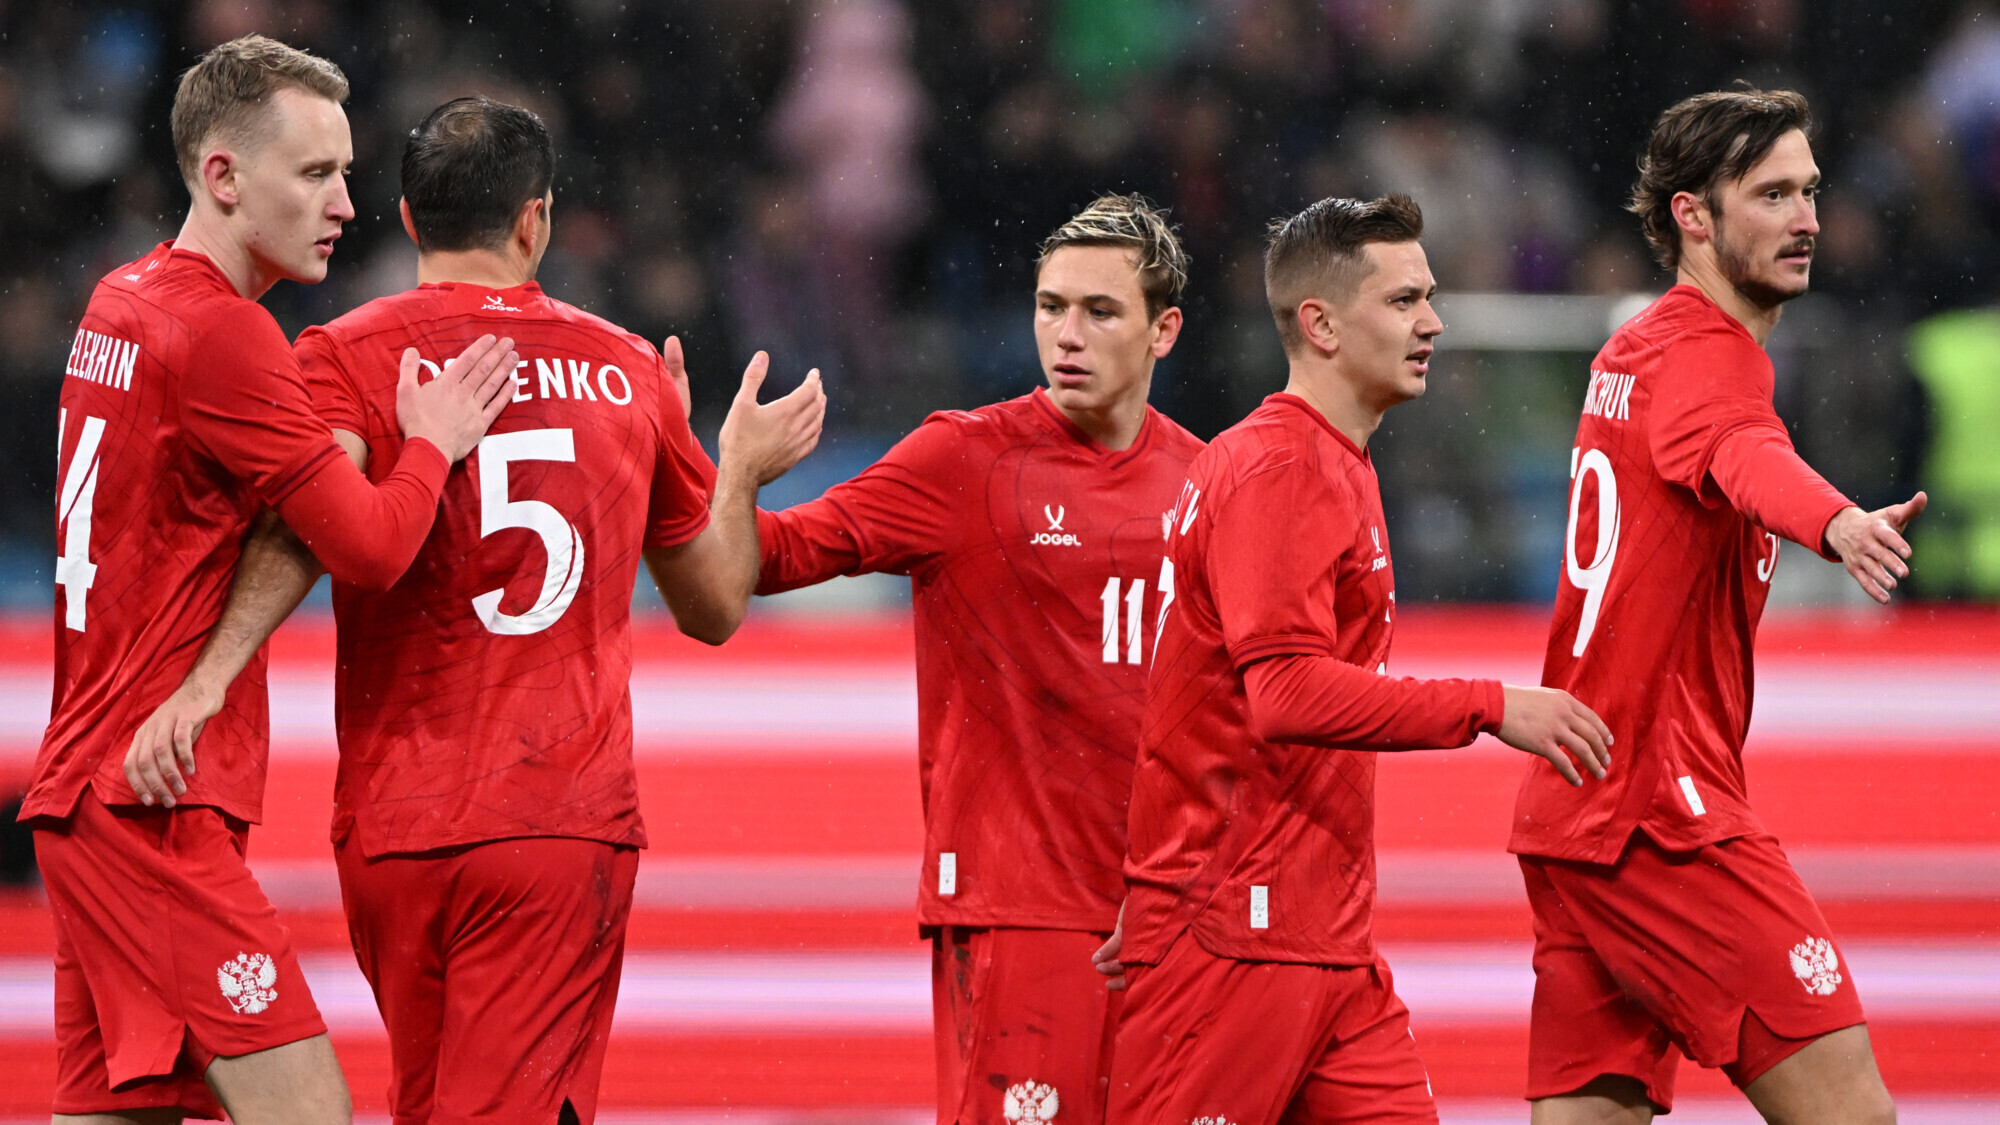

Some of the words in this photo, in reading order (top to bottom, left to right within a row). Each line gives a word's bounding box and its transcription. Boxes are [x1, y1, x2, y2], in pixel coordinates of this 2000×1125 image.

[56, 407, 107, 633] 4
[471, 428, 585, 636] 5
[1030, 532, 1082, 546] JOGEL
[1100, 576, 1146, 665] 11
[1566, 446, 1621, 658] 9
